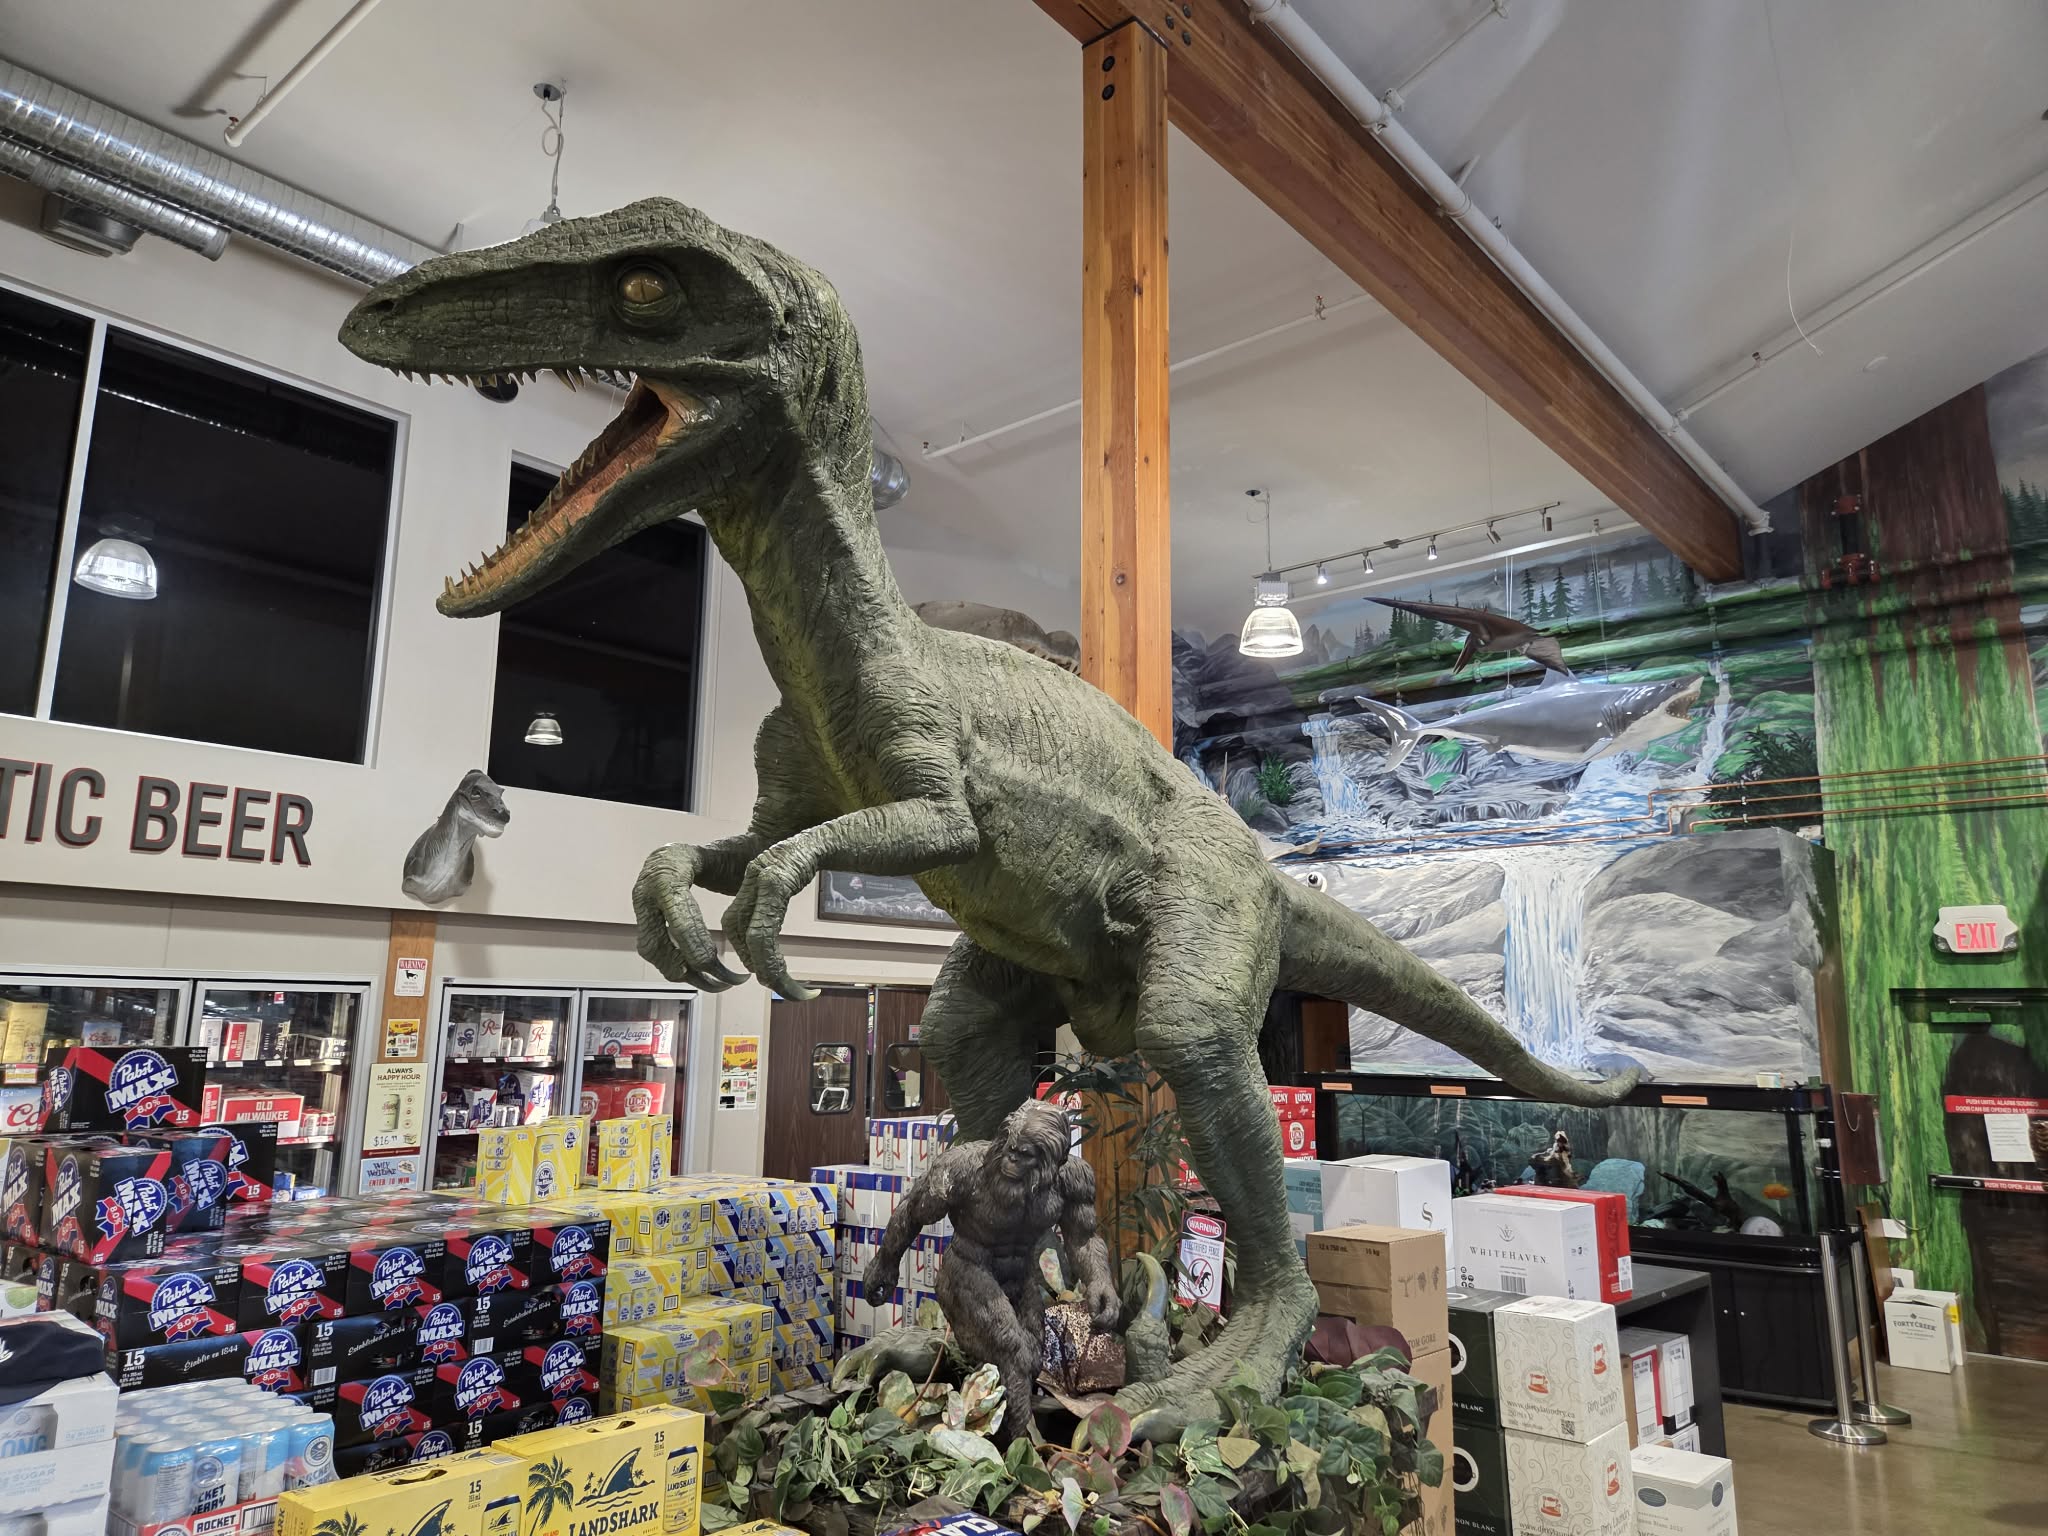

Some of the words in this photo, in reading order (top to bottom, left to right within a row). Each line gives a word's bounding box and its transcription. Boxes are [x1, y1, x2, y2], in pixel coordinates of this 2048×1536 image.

[130, 776, 313, 867] BEER
[1955, 922, 1997, 949] EXIT
[400, 960, 426, 969] WARNING
[602, 1027, 622, 1038] Beer
[622, 1028, 651, 1041] League
[119, 1058, 154, 1085] Pabst
[107, 1068, 176, 1110] MAX
[255, 1101, 273, 1110] OLD
[624, 1097, 652, 1107] LUCKY
[1294, 1093, 1312, 1104] LUCKY
[137, 1099, 161, 1115] 8.0%
[175, 1109, 189, 1121] 15
[236, 1111, 289, 1121] MILWAUKEE
[202, 1164, 220, 1190] Pabst
[184, 1161, 213, 1210] MAX
[247, 1185, 260, 1196] 15
[52, 1181, 81, 1227] MAX
[137, 1182, 159, 1213] Pabst
[117, 1181, 149, 1235] MAX
[1190, 1220, 1219, 1235] WARNING
[557, 1233, 579, 1252] Pabst
[1184, 1240, 1207, 1253] ELECTRIFIED
[1209, 1246, 1220, 1257] FENCE
[472, 1243, 498, 1263] Pabst
[552, 1237, 593, 1269] MAX
[1469, 1246, 1548, 1264] WHITEHAVEN
[61, 1263, 70, 1278] 15
[379, 1255, 406, 1277] Pabst
[468, 1247, 513, 1282] MAX
[569, 1260, 584, 1271] 8.0%
[275, 1267, 305, 1291] Pabst
[372, 1260, 423, 1296] MAX
[486, 1272, 503, 1284] 8.0%
[521, 1279, 529, 1287] 15
[37, 1279, 54, 1297] MAX
[158, 1281, 193, 1306] Pabst
[267, 1272, 322, 1311] MAX
[393, 1286, 412, 1298] 8.0%
[571, 1288, 591, 1302] Pabst
[432, 1293, 440, 1301] 15
[476, 1296, 490, 1311] 15
[95, 1300, 118, 1319] MAX
[151, 1286, 213, 1328] MAX
[290, 1299, 310, 1313] 8.0%
[333, 1308, 342, 1316] 15
[562, 1299, 599, 1317] MAX
[176, 1317, 199, 1330] 8.0%
[430, 1311, 454, 1326] Pabst
[225, 1324, 235, 1332] 15
[316, 1322, 333, 1338] 15
[419, 1323, 463, 1343] MAX
[1914, 1322, 1937, 1331] CREEK
[679, 1334, 693, 1342] Pabst
[1421, 1333, 1436, 1345] GORE
[221, 1344, 238, 1355] 1844
[260, 1339, 288, 1354] Pabst
[432, 1342, 449, 1350] 8.0%
[125, 1350, 145, 1367] 15
[247, 1350, 299, 1372] MAX
[547, 1348, 570, 1369] Pabst
[262, 1372, 281, 1380] 8.0%
[462, 1363, 488, 1387] Pabst
[542, 1352, 585, 1388] MAX
[458, 1368, 503, 1406] MAX
[560, 1376, 576, 1389] 8.0%
[367, 1382, 396, 1407] Pabst
[677, 1388, 690, 1396] Pabst
[361, 1387, 413, 1428] MAX
[476, 1394, 494, 1408] 8.0%
[512, 1400, 520, 1408] 15
[1460, 1403, 1484, 1413] BLANC
[564, 1406, 585, 1420] Pabst
[1506, 1400, 1575, 1418] www.dirtylaundry.ca
[383, 1414, 402, 1429] 8.0%
[423, 1421, 431, 1429] 15
[467, 1419, 483, 1435] 15
[654, 1431, 665, 1443] 15
[420, 1440, 444, 1455] Pabst
[469, 1480, 482, 1494] 15
[667, 1478, 696, 1492] LANDSHARK
[196, 1514, 237, 1533] ROCKET
[569, 1501, 660, 1536] LANDSHARK
[1472, 1521, 1496, 1533] BLANC
